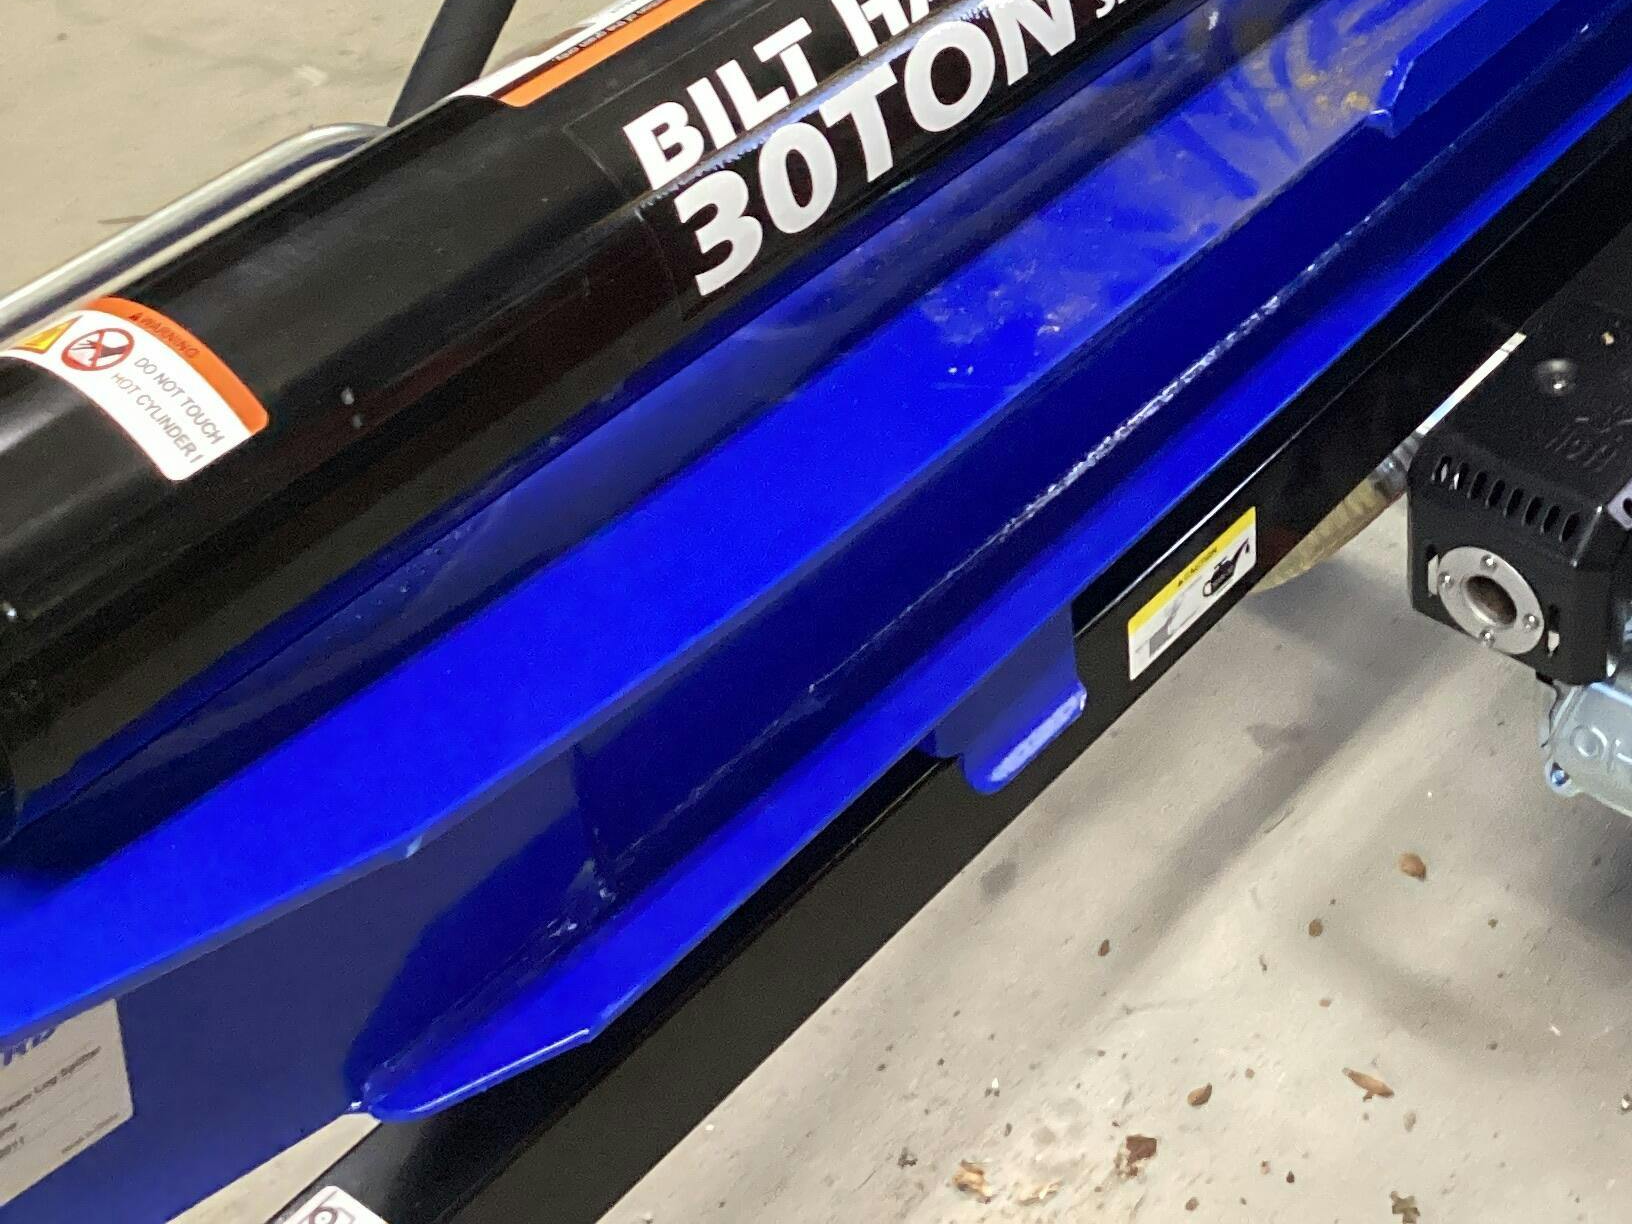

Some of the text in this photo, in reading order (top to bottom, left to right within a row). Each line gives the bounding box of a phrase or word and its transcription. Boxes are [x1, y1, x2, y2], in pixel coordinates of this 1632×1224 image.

[622, 16, 820, 190] BILT
[110, 372, 140, 397] HOT
[133, 356, 226, 445] DO NOT TOUCH
